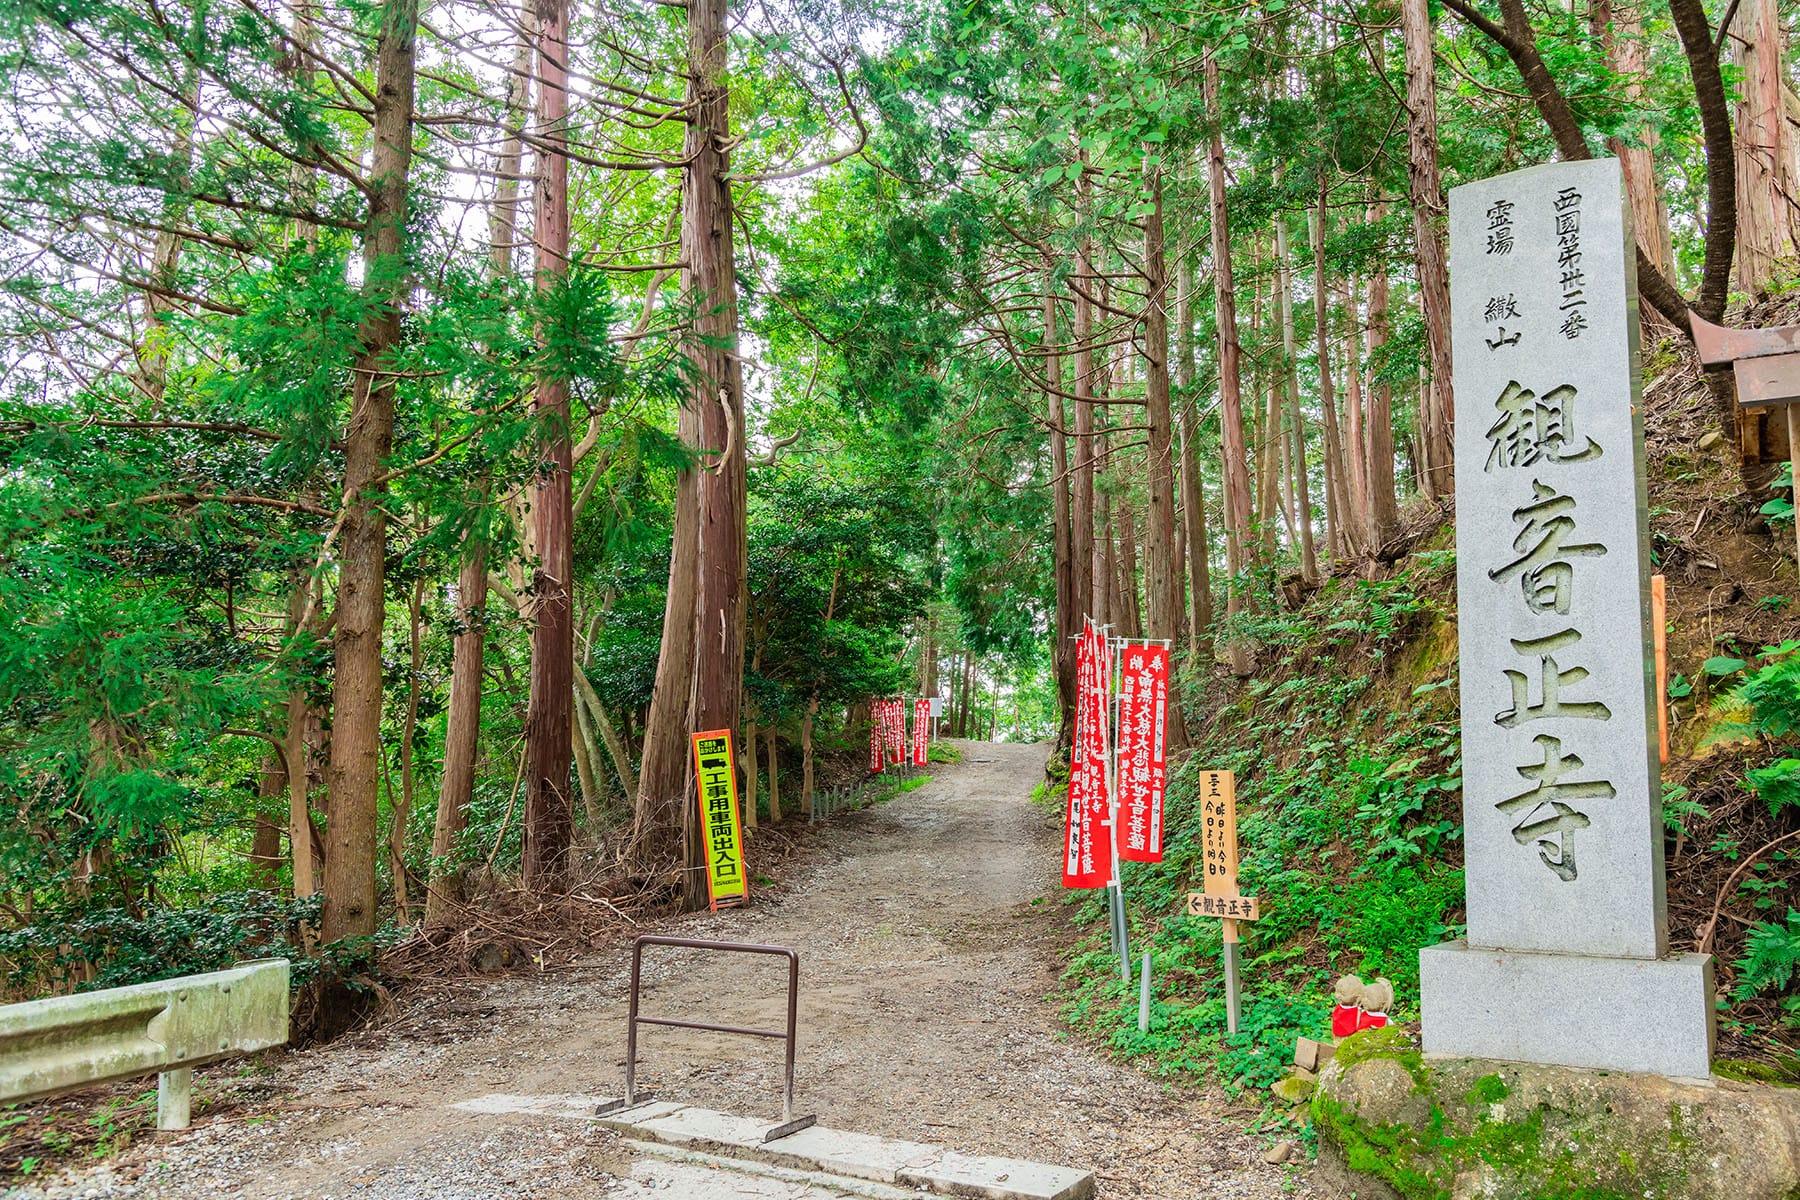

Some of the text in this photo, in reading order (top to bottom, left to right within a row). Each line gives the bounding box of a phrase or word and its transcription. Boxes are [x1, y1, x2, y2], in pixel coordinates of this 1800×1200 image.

[1484, 379, 1617, 882] 観音正寺
[705, 772, 737, 878] 工事用車両出入口
[1205, 800, 1217, 876] 今日より明日
[1215, 801, 1227, 876] 昨日より今日
[1203, 896, 1253, 917] 観音正寺
